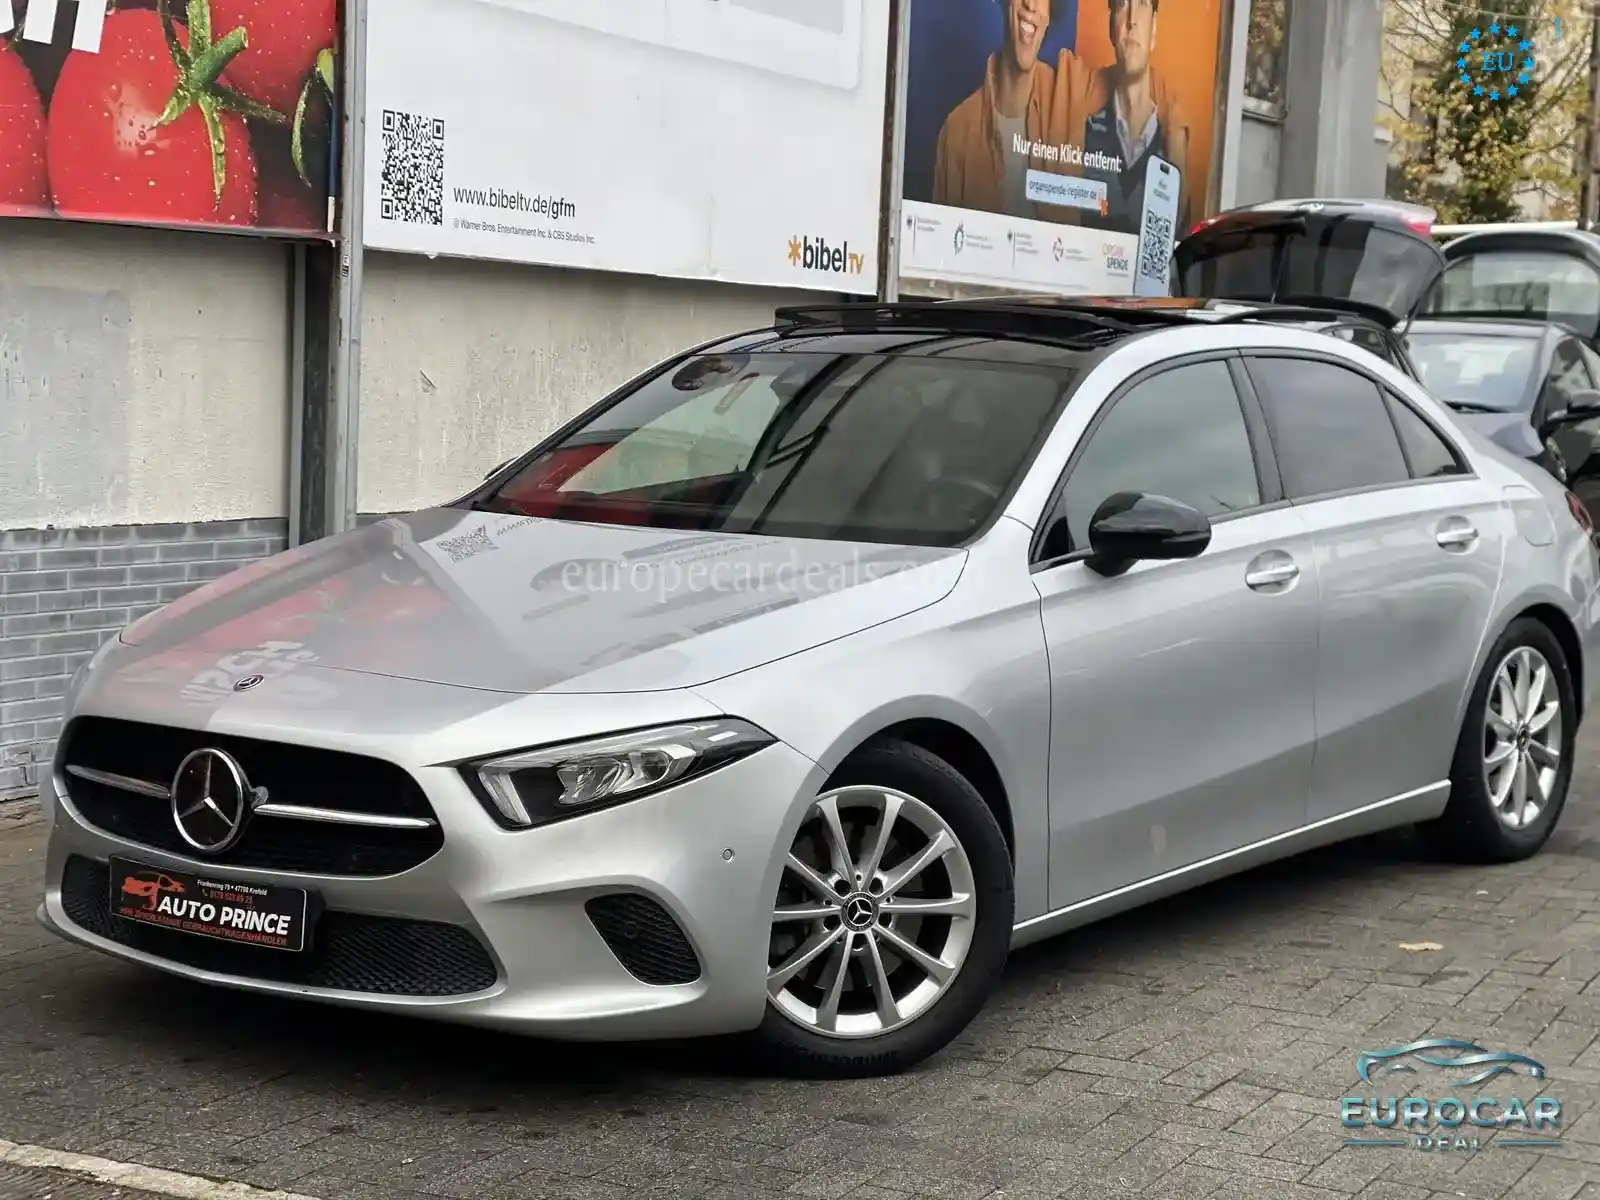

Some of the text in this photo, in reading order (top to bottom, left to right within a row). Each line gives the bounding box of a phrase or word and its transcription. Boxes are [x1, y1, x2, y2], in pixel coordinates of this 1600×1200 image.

[1013, 133, 1031, 155] Nur
[1032, 139, 1058, 161] einen
[1059, 143, 1083, 166] Klick
[453, 187, 576, 220] www.bibeltv.de/gfm
[460, 219, 481, 231] Warner
[497, 223, 537, 238] Entertainment
[547, 229, 553, 240] &
[565, 231, 585, 243] Studios
[157, 896, 216, 922] AUTO
[219, 906, 291, 935] PRINCE
